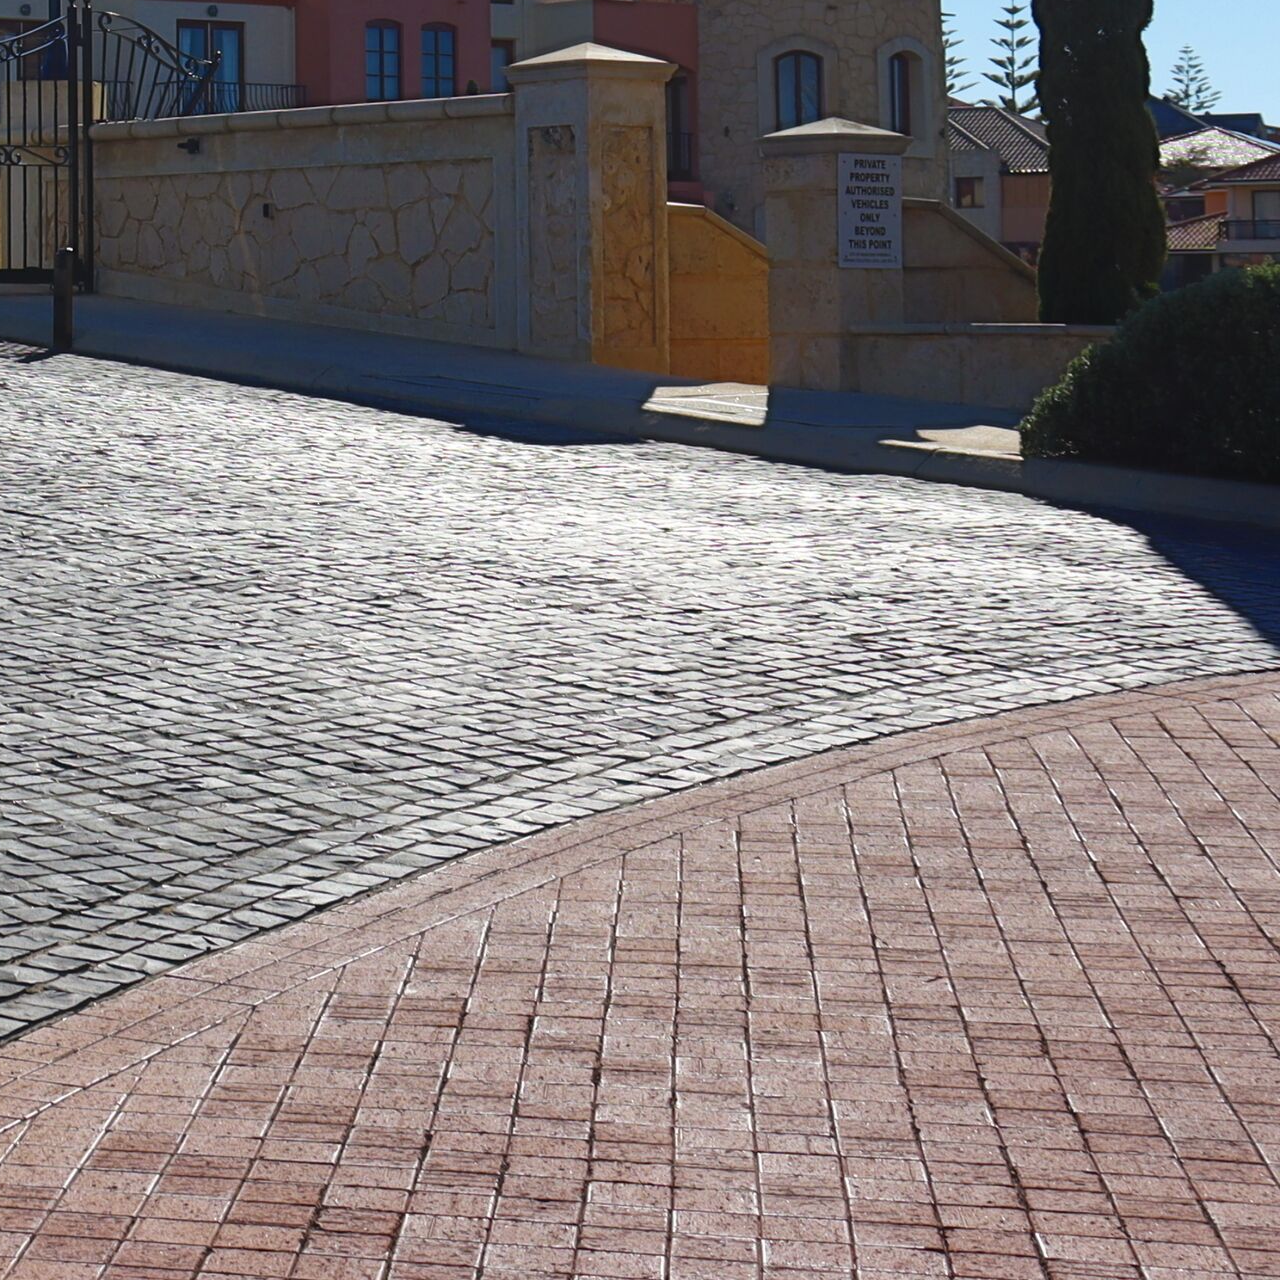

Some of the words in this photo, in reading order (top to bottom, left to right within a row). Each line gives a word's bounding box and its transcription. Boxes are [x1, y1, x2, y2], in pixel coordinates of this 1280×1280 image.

[854, 159, 886, 169] PRIVATE
[849, 172, 890, 183] PROPERTY
[845, 186, 895, 196] AUTHORISED
[851, 199, 889, 209] VEHICLES
[860, 213, 880, 222] ONLY
[854, 226, 886, 236] BEYOND
[848, 239, 867, 249] THIS
[869, 240, 892, 249] POINT
